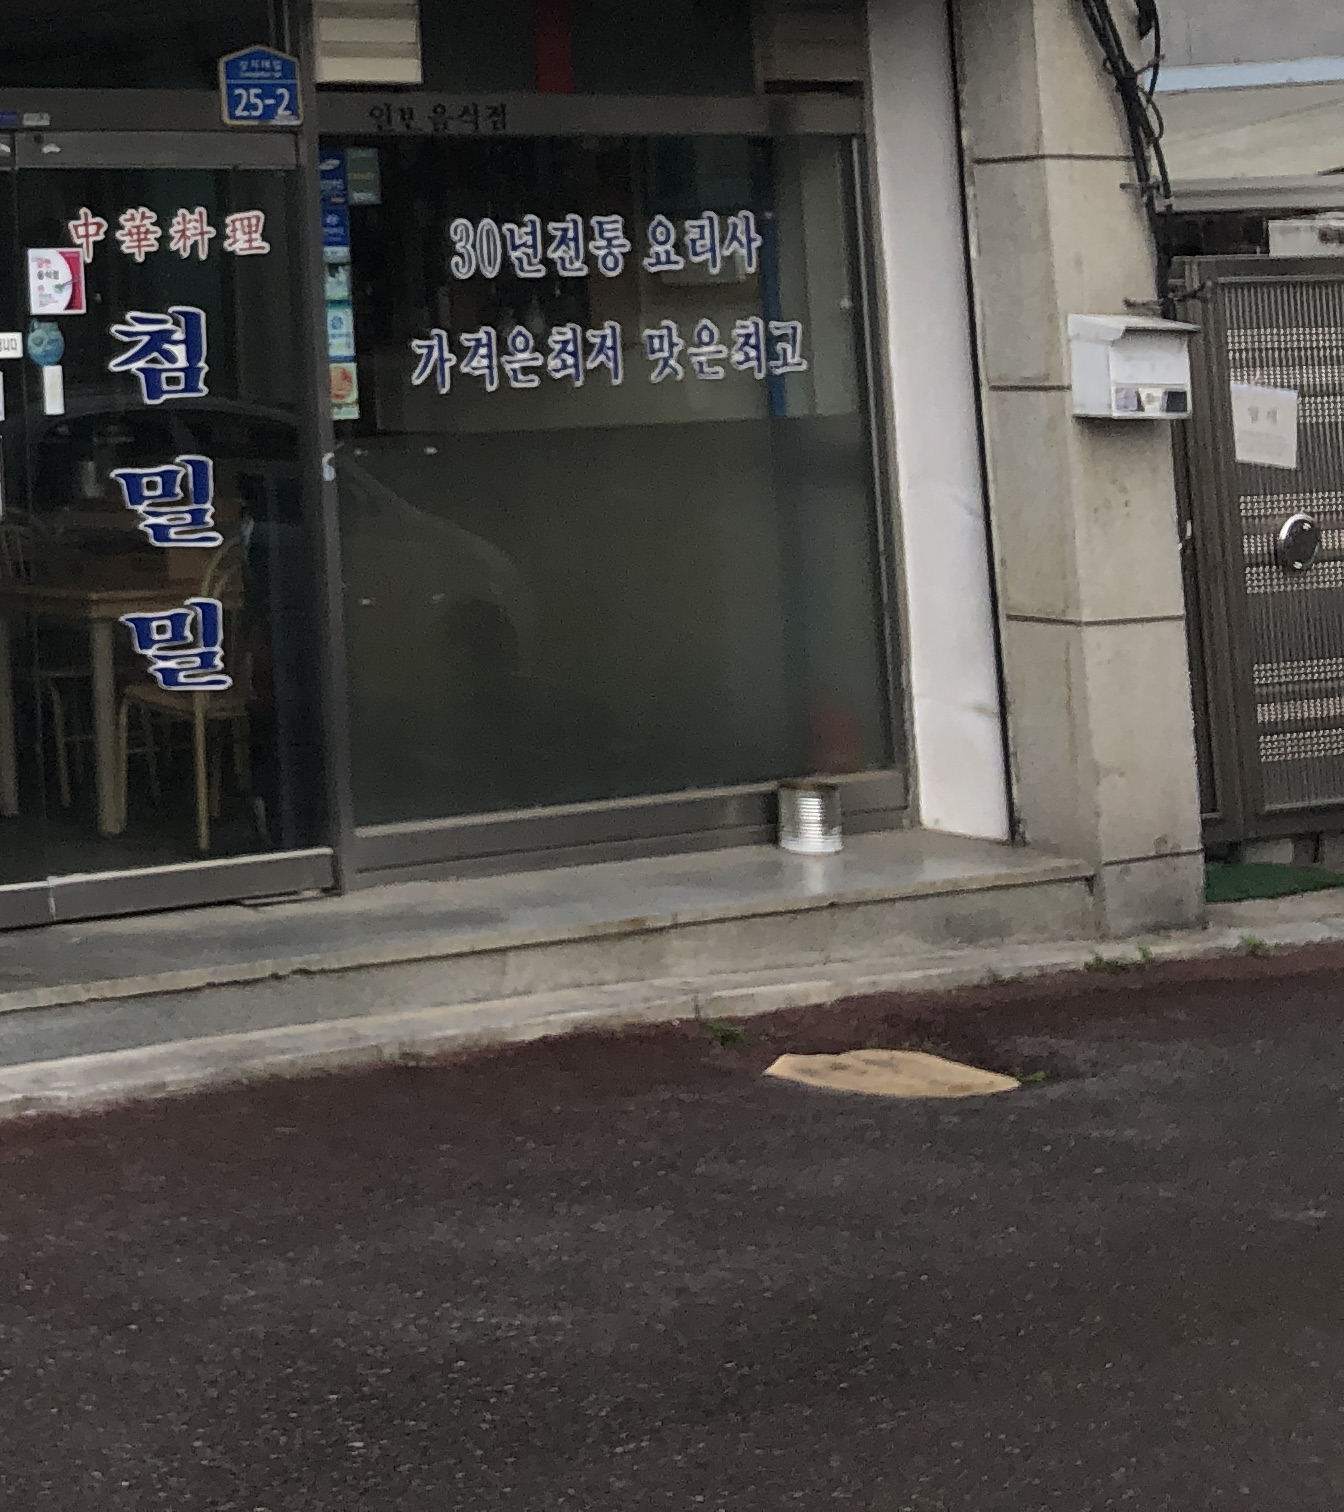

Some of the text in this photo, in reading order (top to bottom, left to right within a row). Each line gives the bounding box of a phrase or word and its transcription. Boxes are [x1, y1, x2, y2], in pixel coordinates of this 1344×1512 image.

[234, 88, 292, 116] 25-2
[68, 207, 270, 263] 中華料理
[450, 210, 762, 279] 30년전통 요리사
[410, 321, 623, 393] 가격은최저
